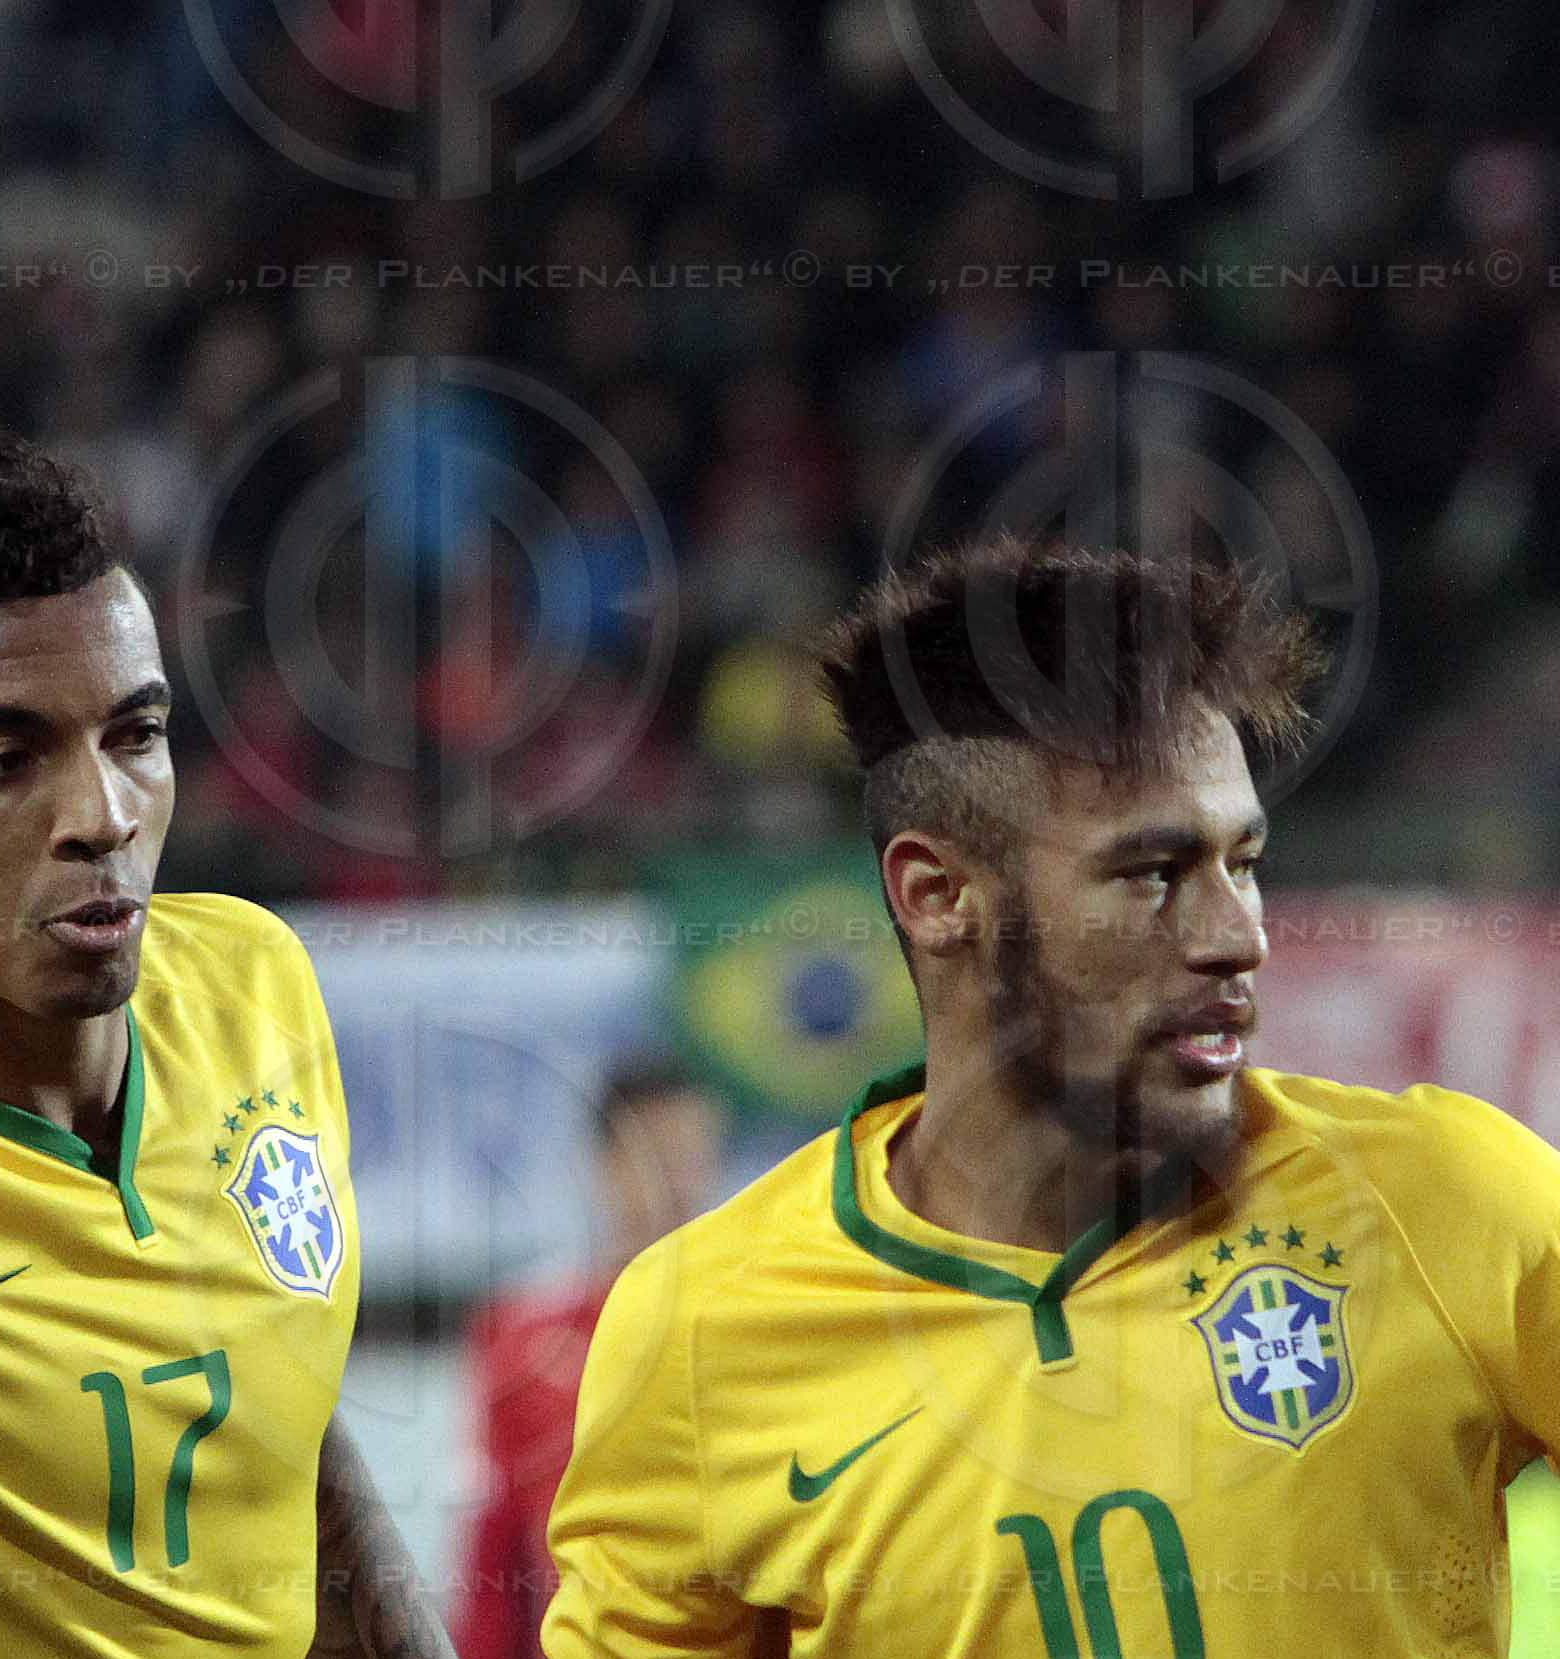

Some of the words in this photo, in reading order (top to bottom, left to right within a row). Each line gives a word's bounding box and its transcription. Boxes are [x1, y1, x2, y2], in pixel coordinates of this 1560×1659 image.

[277, 1189, 306, 1220] CBF
[1254, 1336, 1305, 1363] CBF
[80, 1348, 232, 1574] 17
